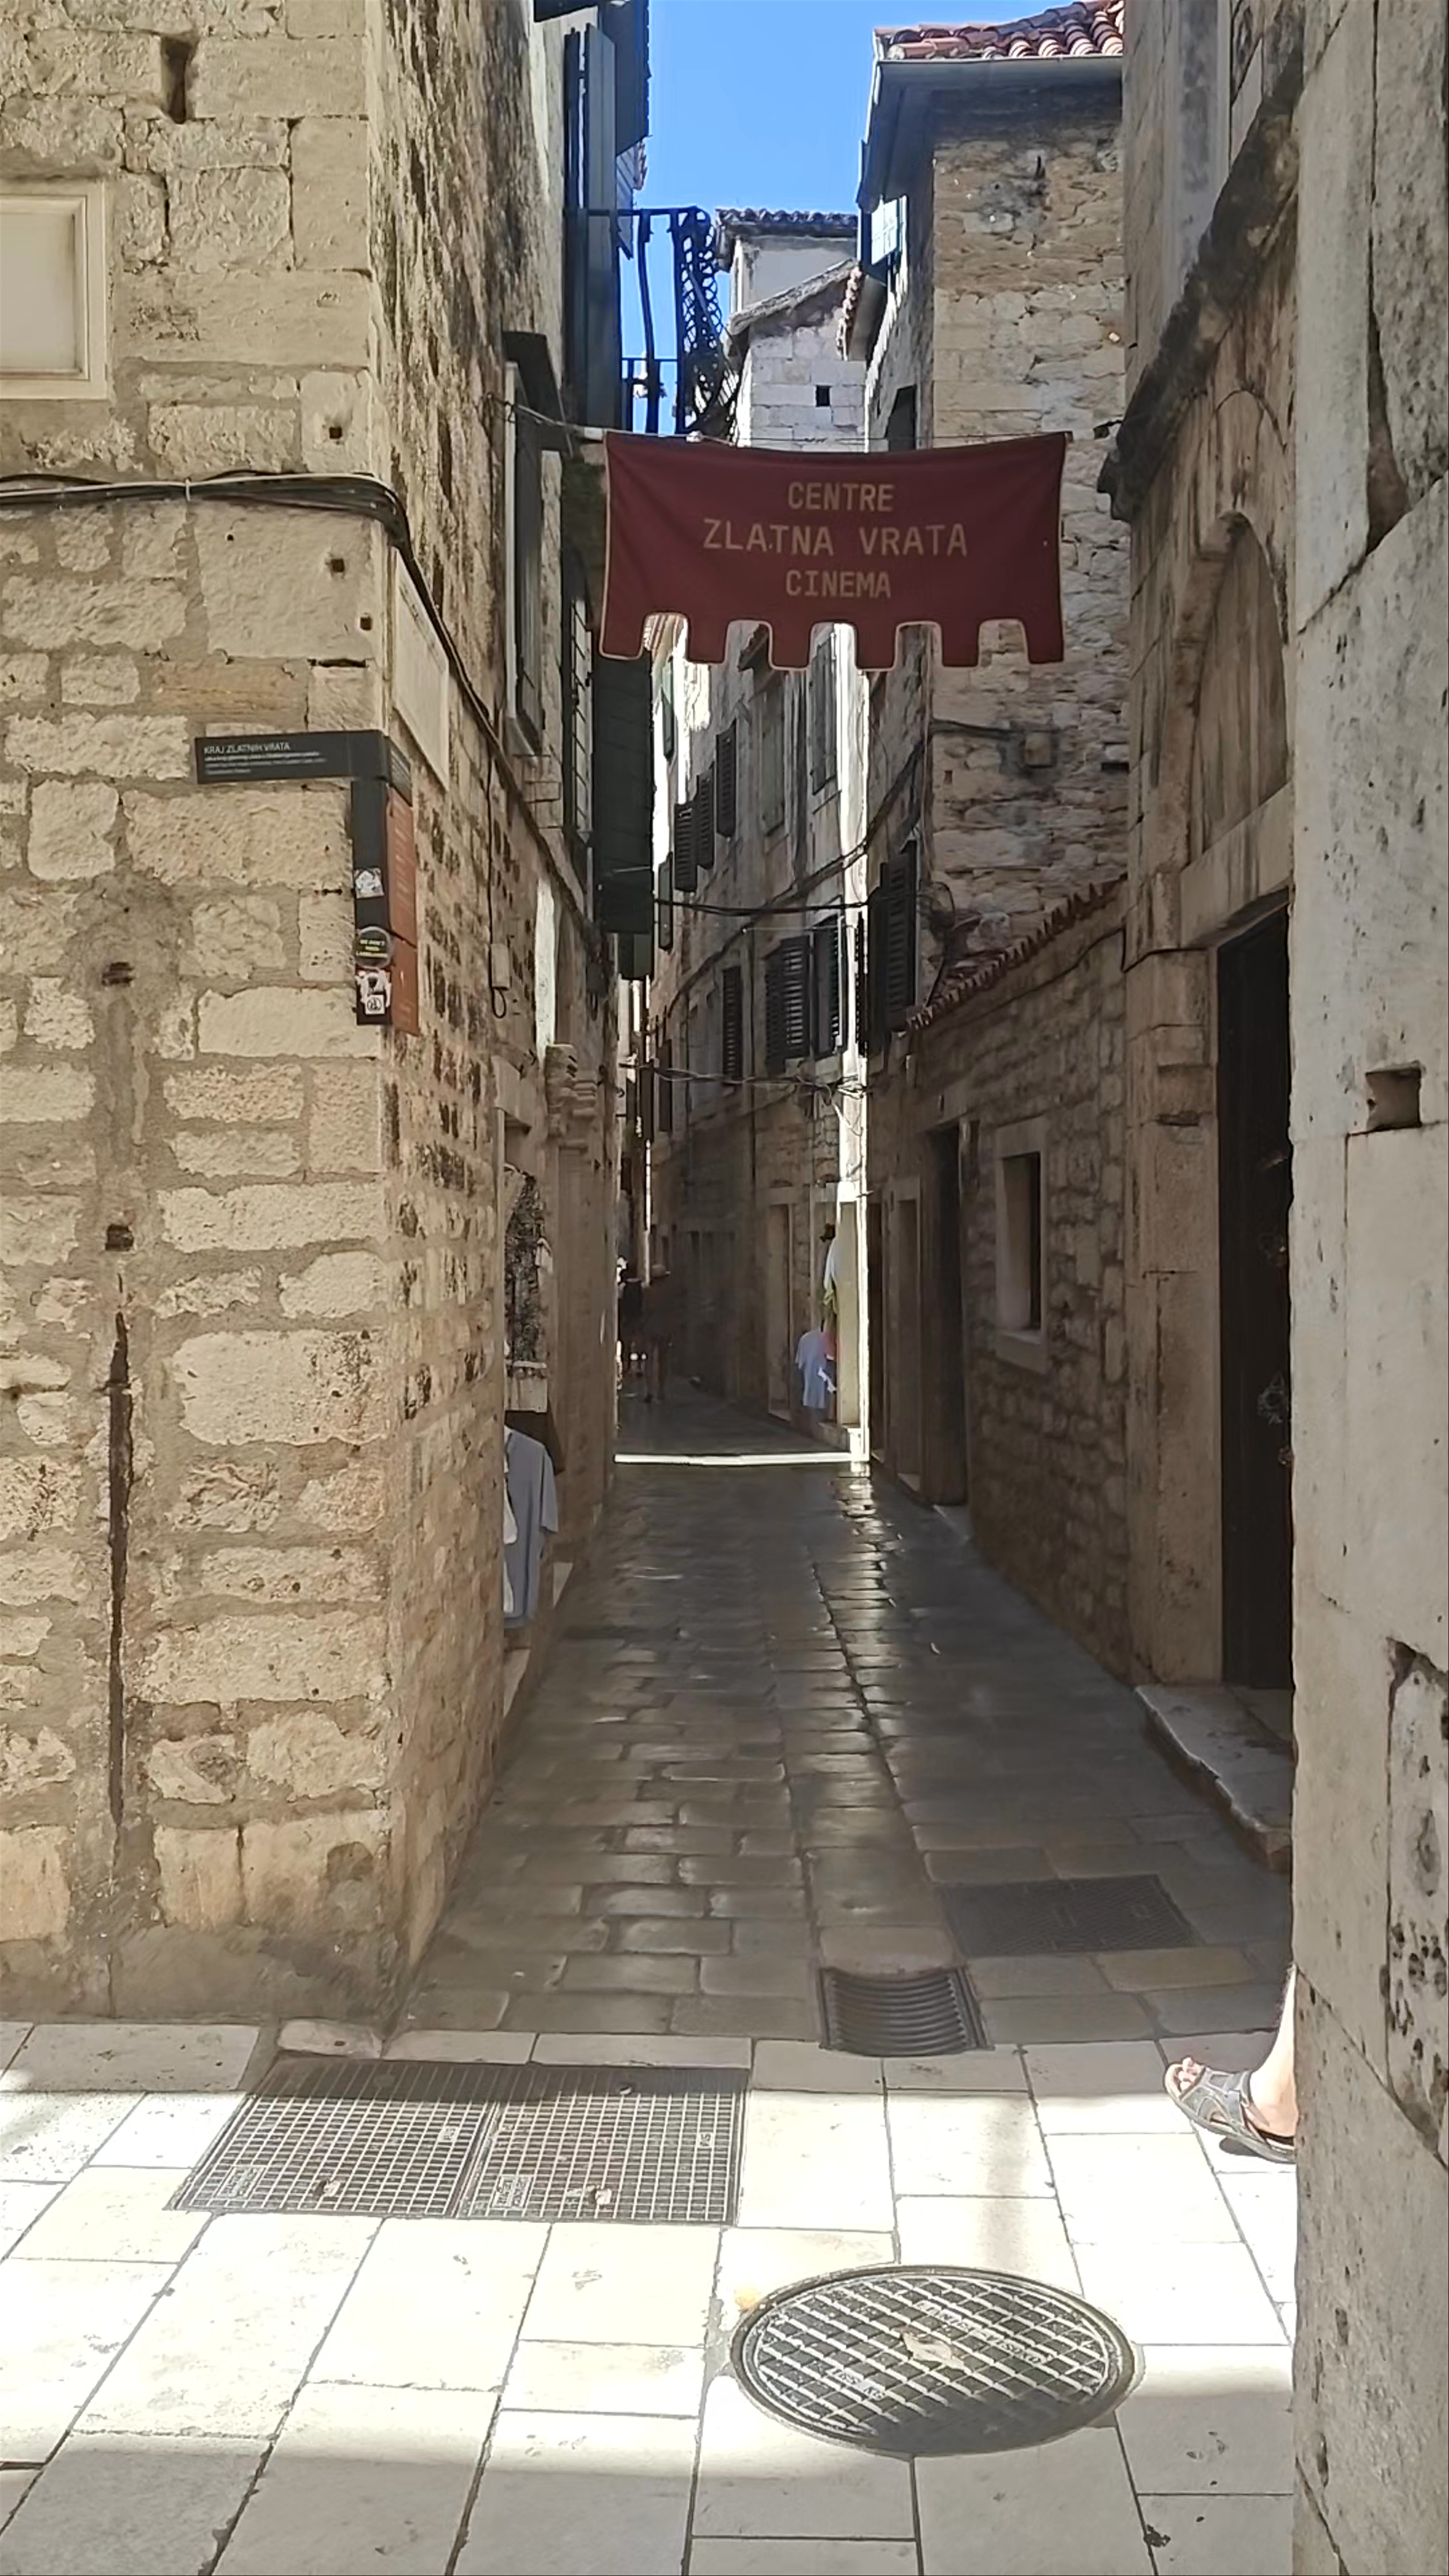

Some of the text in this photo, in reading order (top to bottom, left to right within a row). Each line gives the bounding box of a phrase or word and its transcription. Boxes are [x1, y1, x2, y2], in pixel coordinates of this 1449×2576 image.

[788, 482, 895, 512] CENTRE
[703, 518, 967, 557] ZLATNA VRATA
[786, 570, 891, 598] CINEMA
[204, 742, 290, 754] KRAJ ZLATNIH VRATA
